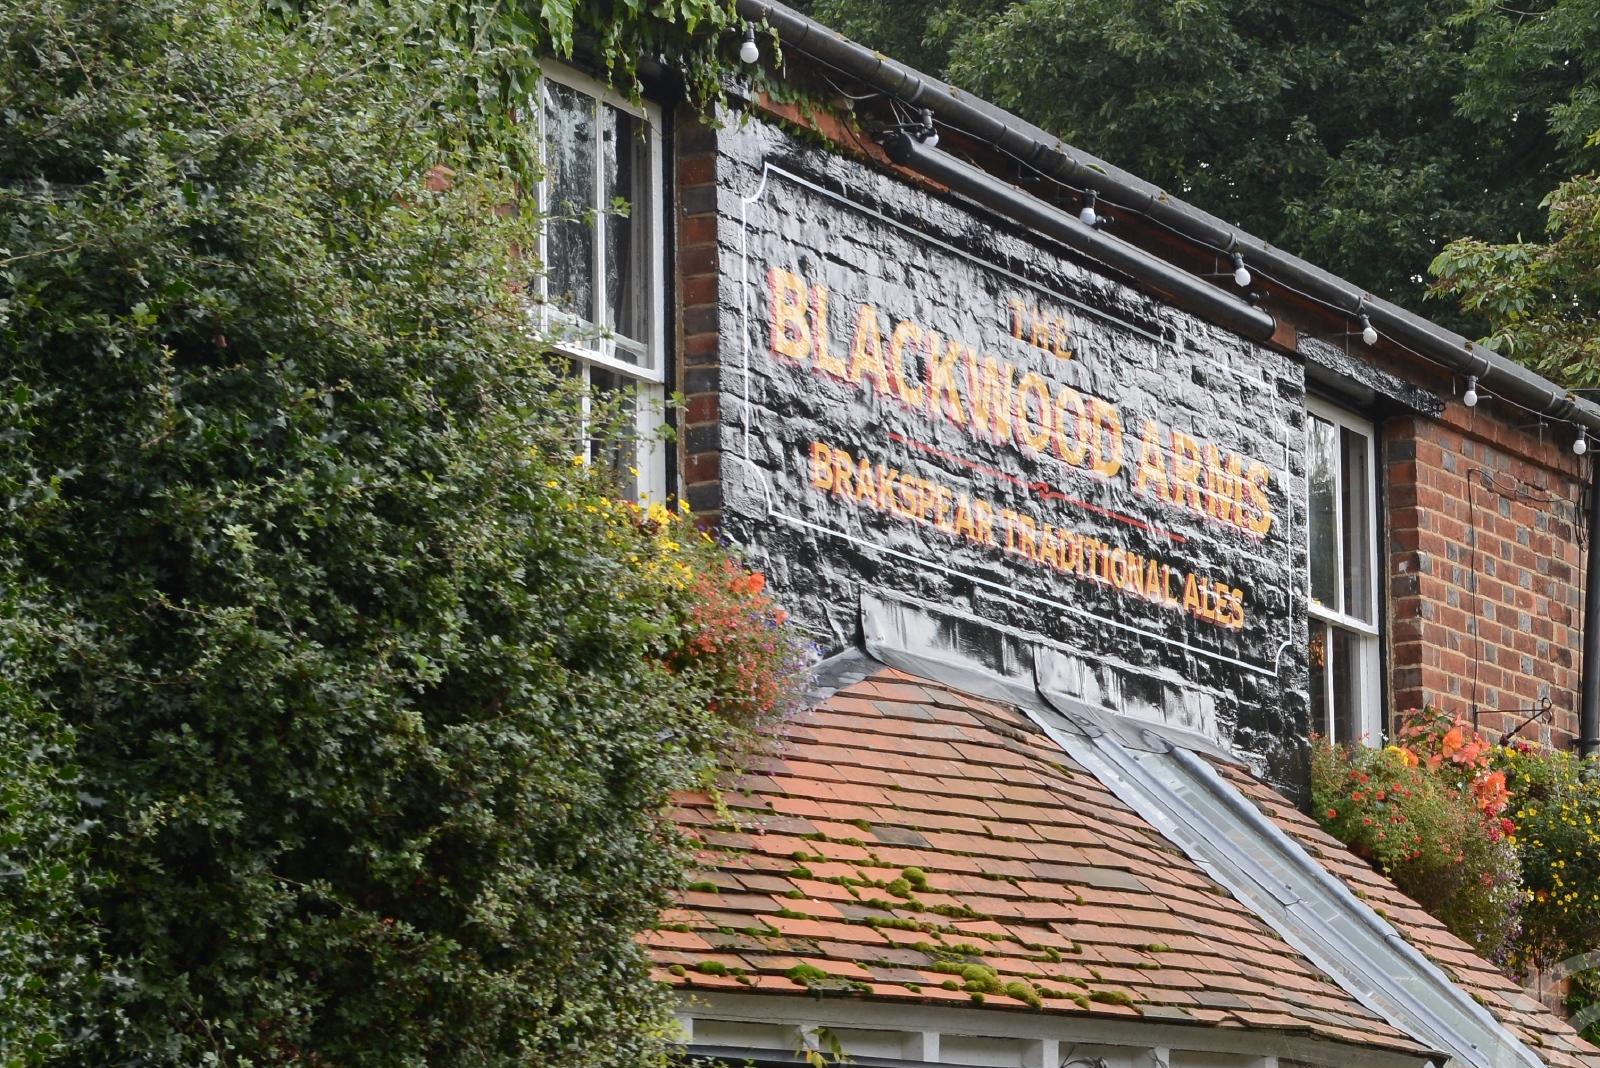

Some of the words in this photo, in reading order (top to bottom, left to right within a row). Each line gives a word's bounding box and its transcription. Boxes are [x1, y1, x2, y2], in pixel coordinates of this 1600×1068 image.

[767, 266, 1123, 480] BLACKWOOD
[1132, 419, 1272, 541] ARMS
[1008, 298, 1074, 361] THE
[810, 441, 994, 546] BRAKSPEAR
[1002, 508, 1178, 608] TRADITIONAL
[1183, 572, 1244, 630] ALES
